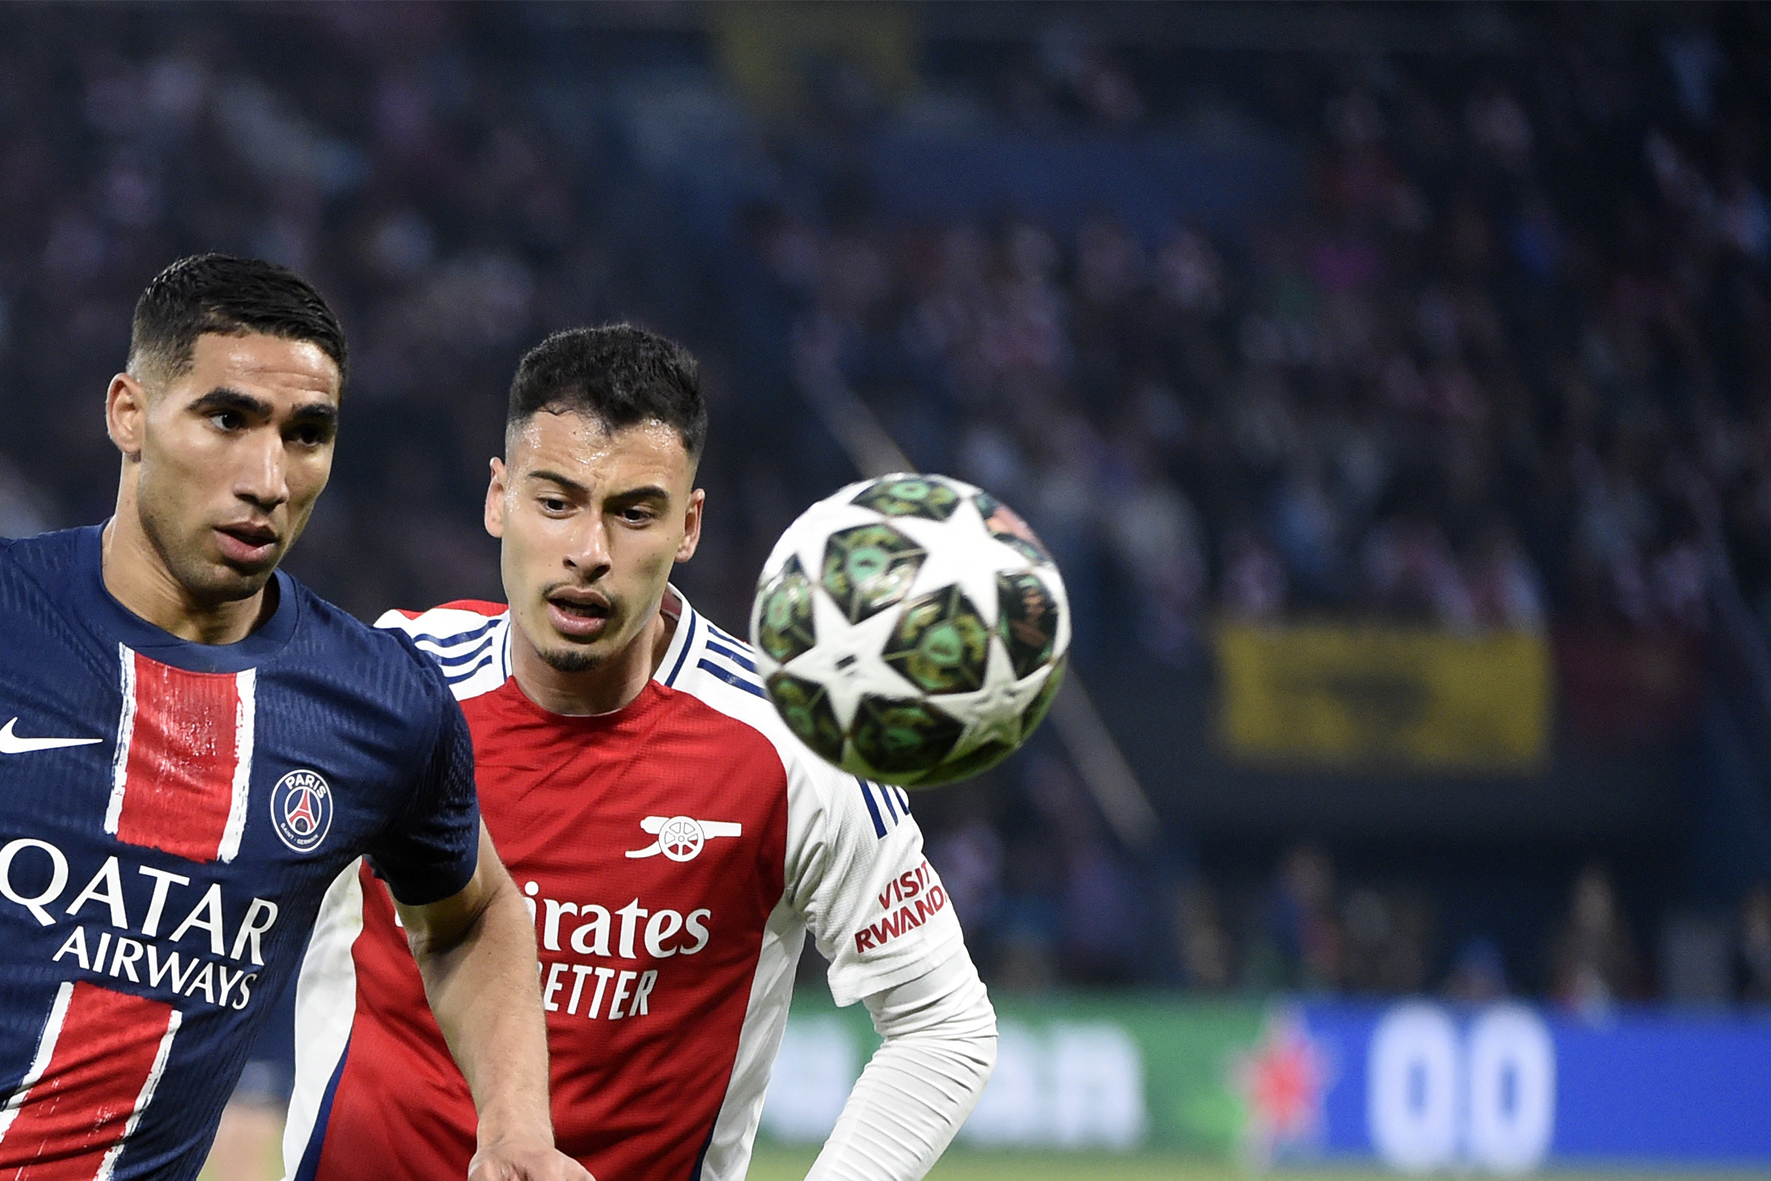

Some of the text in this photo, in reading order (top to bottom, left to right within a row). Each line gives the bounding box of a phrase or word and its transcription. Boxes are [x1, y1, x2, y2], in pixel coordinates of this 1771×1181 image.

[285, 773, 327, 799] PARIS
[878, 859, 931, 911] VISIT
[525, 881, 712, 959] irates
[854, 884, 948, 954] RWAND
[52, 925, 258, 1011] AIRWAYS
[539, 962, 659, 1021] ETTER
